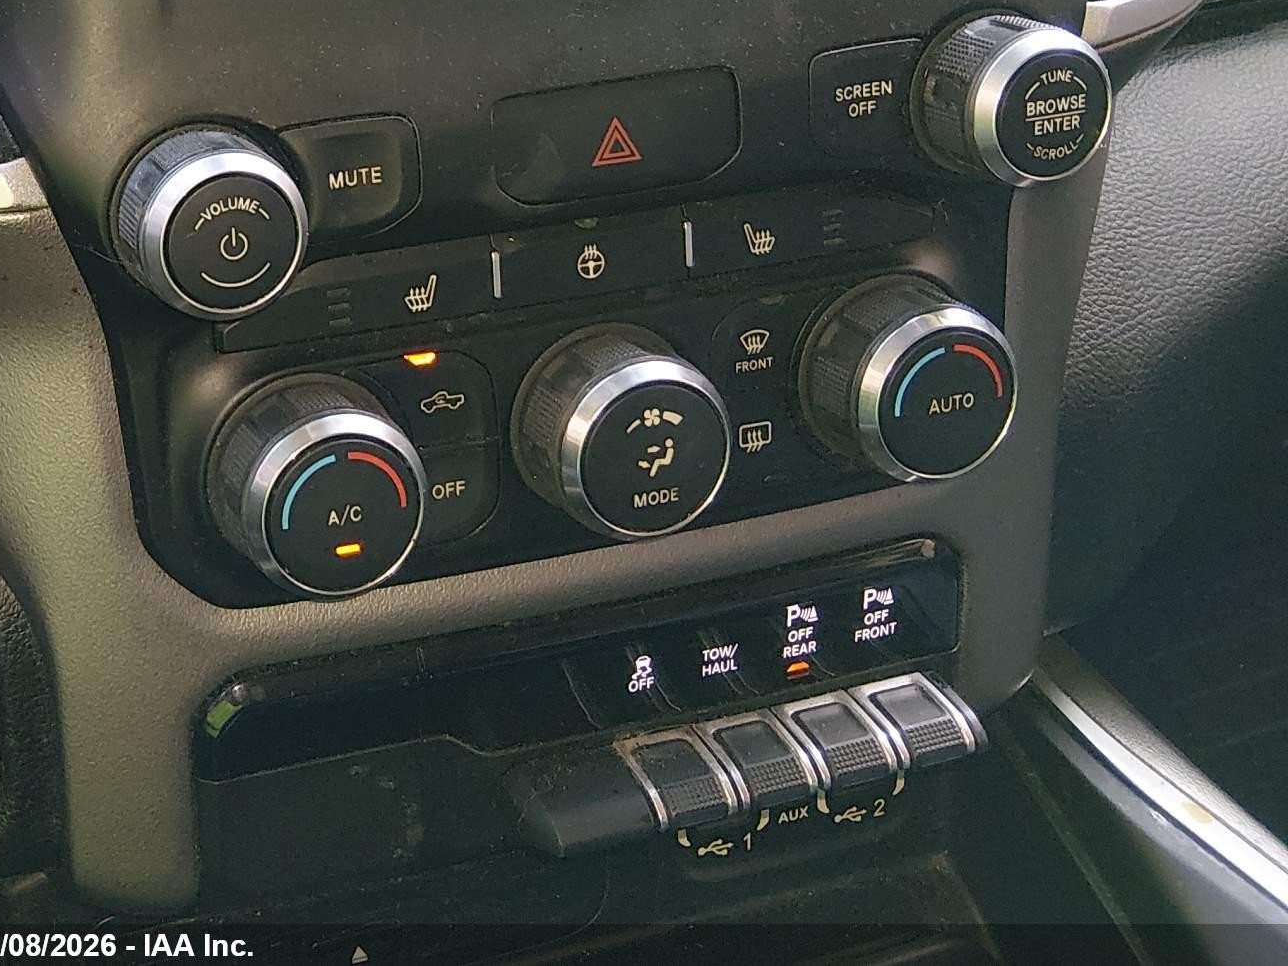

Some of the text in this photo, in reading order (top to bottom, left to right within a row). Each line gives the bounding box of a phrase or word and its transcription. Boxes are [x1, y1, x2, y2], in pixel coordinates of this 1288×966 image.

[1040, 68, 1074, 86] TUNE
[835, 80, 892, 103] SCREEN
[848, 99, 877, 118] OFF
[1026, 93, 1086, 117] BROWSE
[1034, 115, 1081, 136] ENTER
[1033, 140, 1079, 161] SCROLL
[328, 166, 382, 190] MUTE
[200, 196, 260, 222] VOLUME
[734, 356, 774, 374] FRONT
[928, 392, 975, 416] AUTO
[431, 480, 466, 501] OFF
[633, 486, 680, 509] MODE
[328, 504, 362, 527] A/C
[863, 608, 890, 626] OFF
[787, 626, 814, 643] OFF
[854, 621, 897, 643] FRONT
[702, 642, 739, 662] TOW/
[782, 640, 817, 659] REAR
[701, 658, 738, 677] HAUL
[628, 676, 654, 693] OFF
[777, 805, 809, 825] AUX
[873, 799, 887, 818] 2
[743, 833, 753, 852] 1
